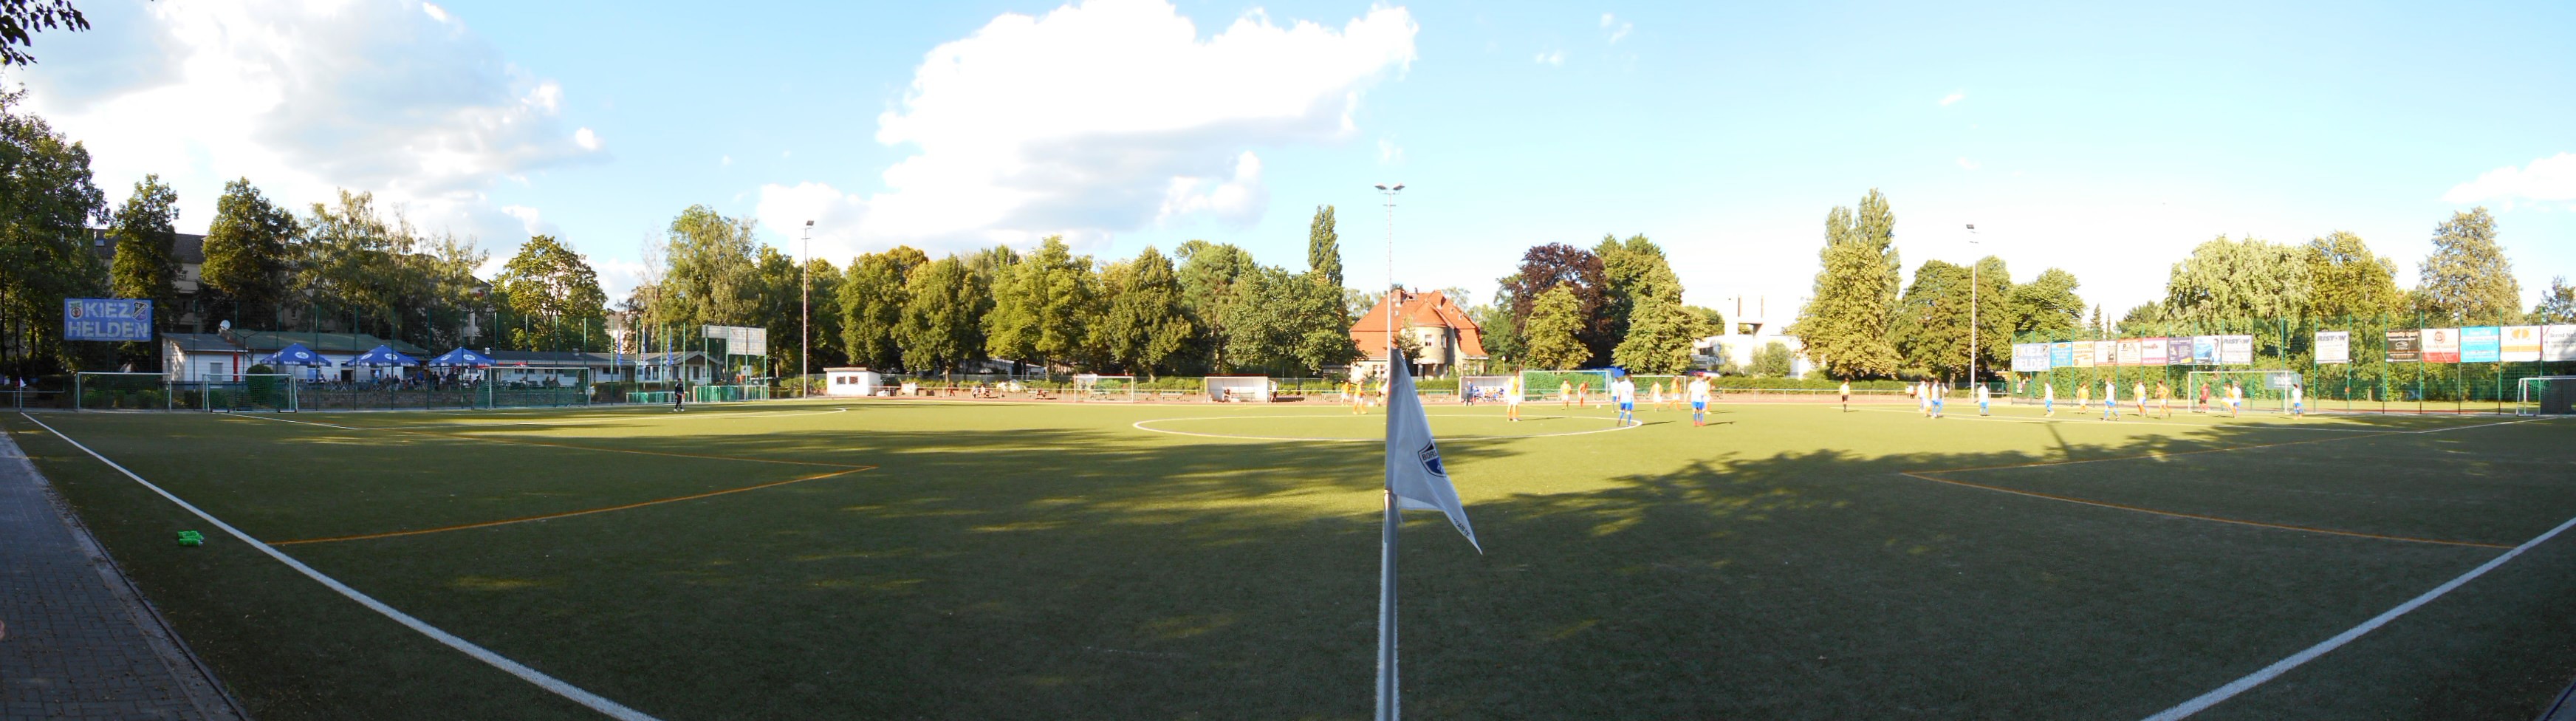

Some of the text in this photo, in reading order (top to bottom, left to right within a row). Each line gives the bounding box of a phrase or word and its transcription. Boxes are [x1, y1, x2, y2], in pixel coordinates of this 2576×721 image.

[85, 302, 131, 318] KIEZ
[68, 321, 148, 338] HELDEN
[2021, 345, 2042, 356] KIEZ
[2013, 358, 2050, 369] HELDEN
